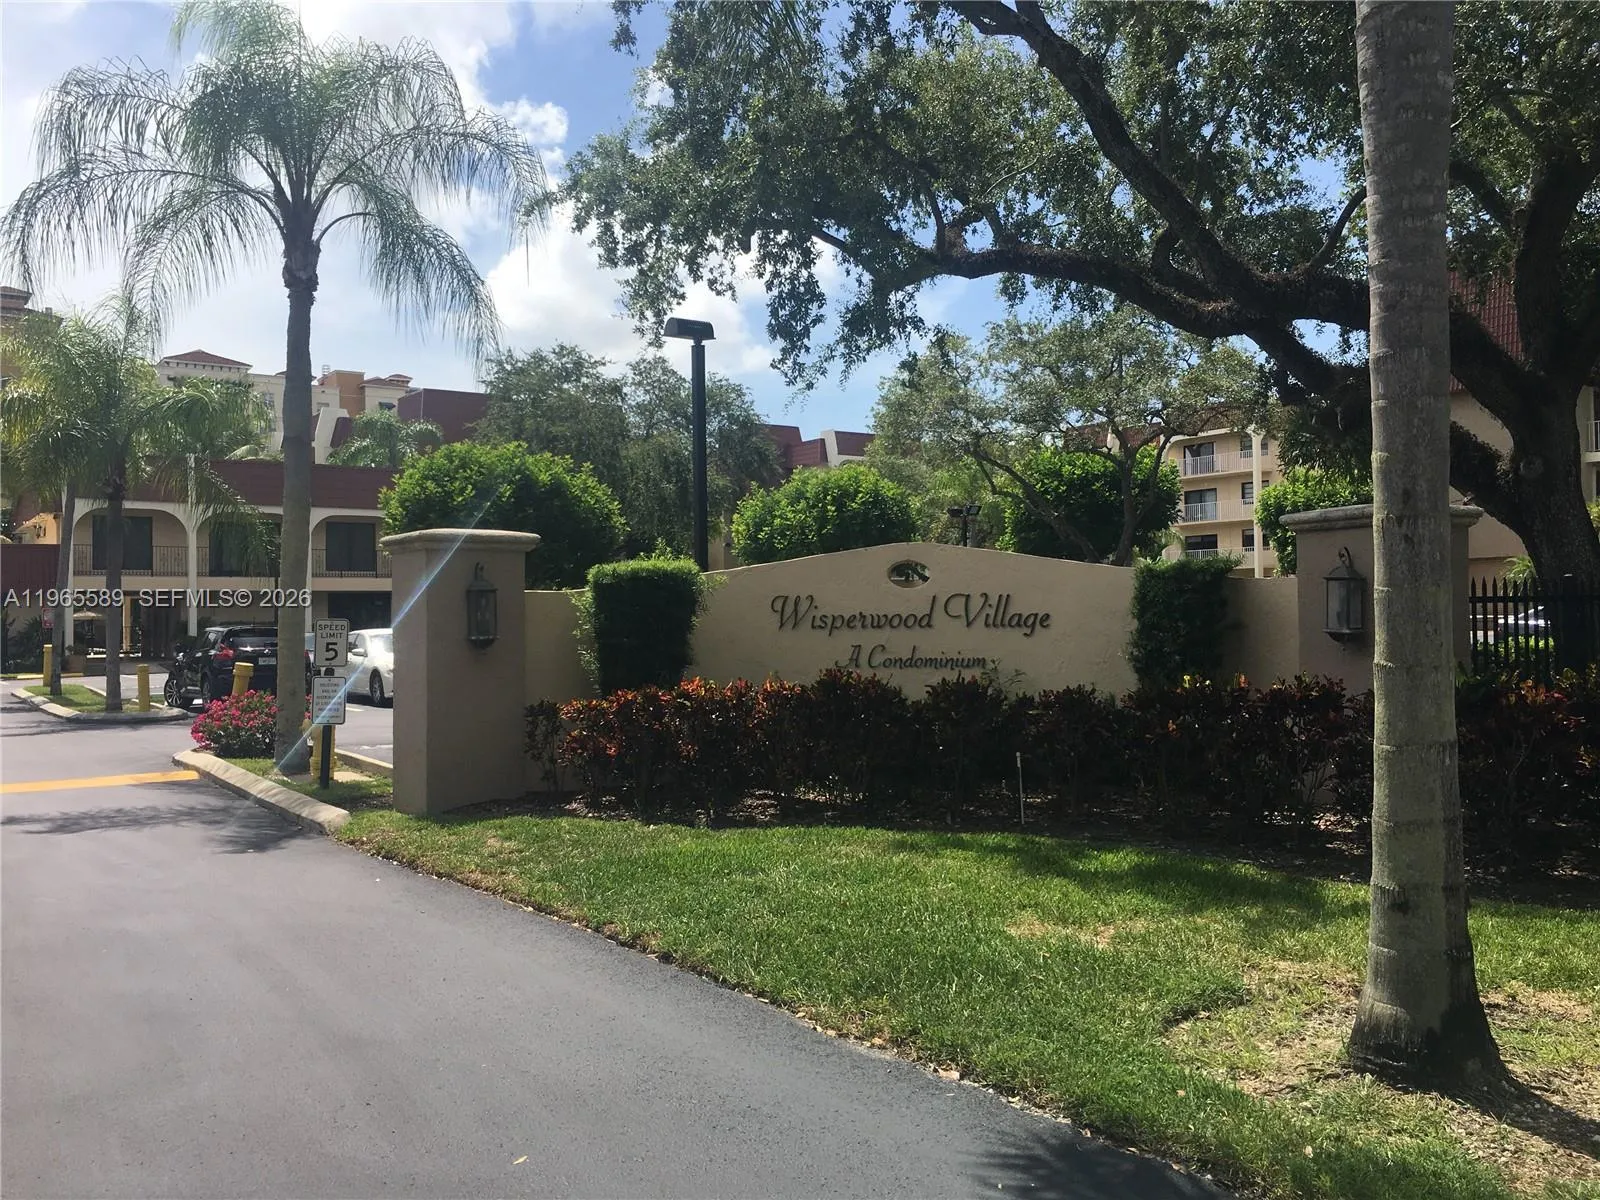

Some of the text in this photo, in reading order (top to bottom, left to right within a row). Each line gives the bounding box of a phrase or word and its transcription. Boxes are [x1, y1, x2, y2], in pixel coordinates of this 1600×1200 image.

[770, 592, 1051, 637] Wisperwood Village
[325, 641, 339, 661] 5
[834, 643, 987, 670] A Condominium
